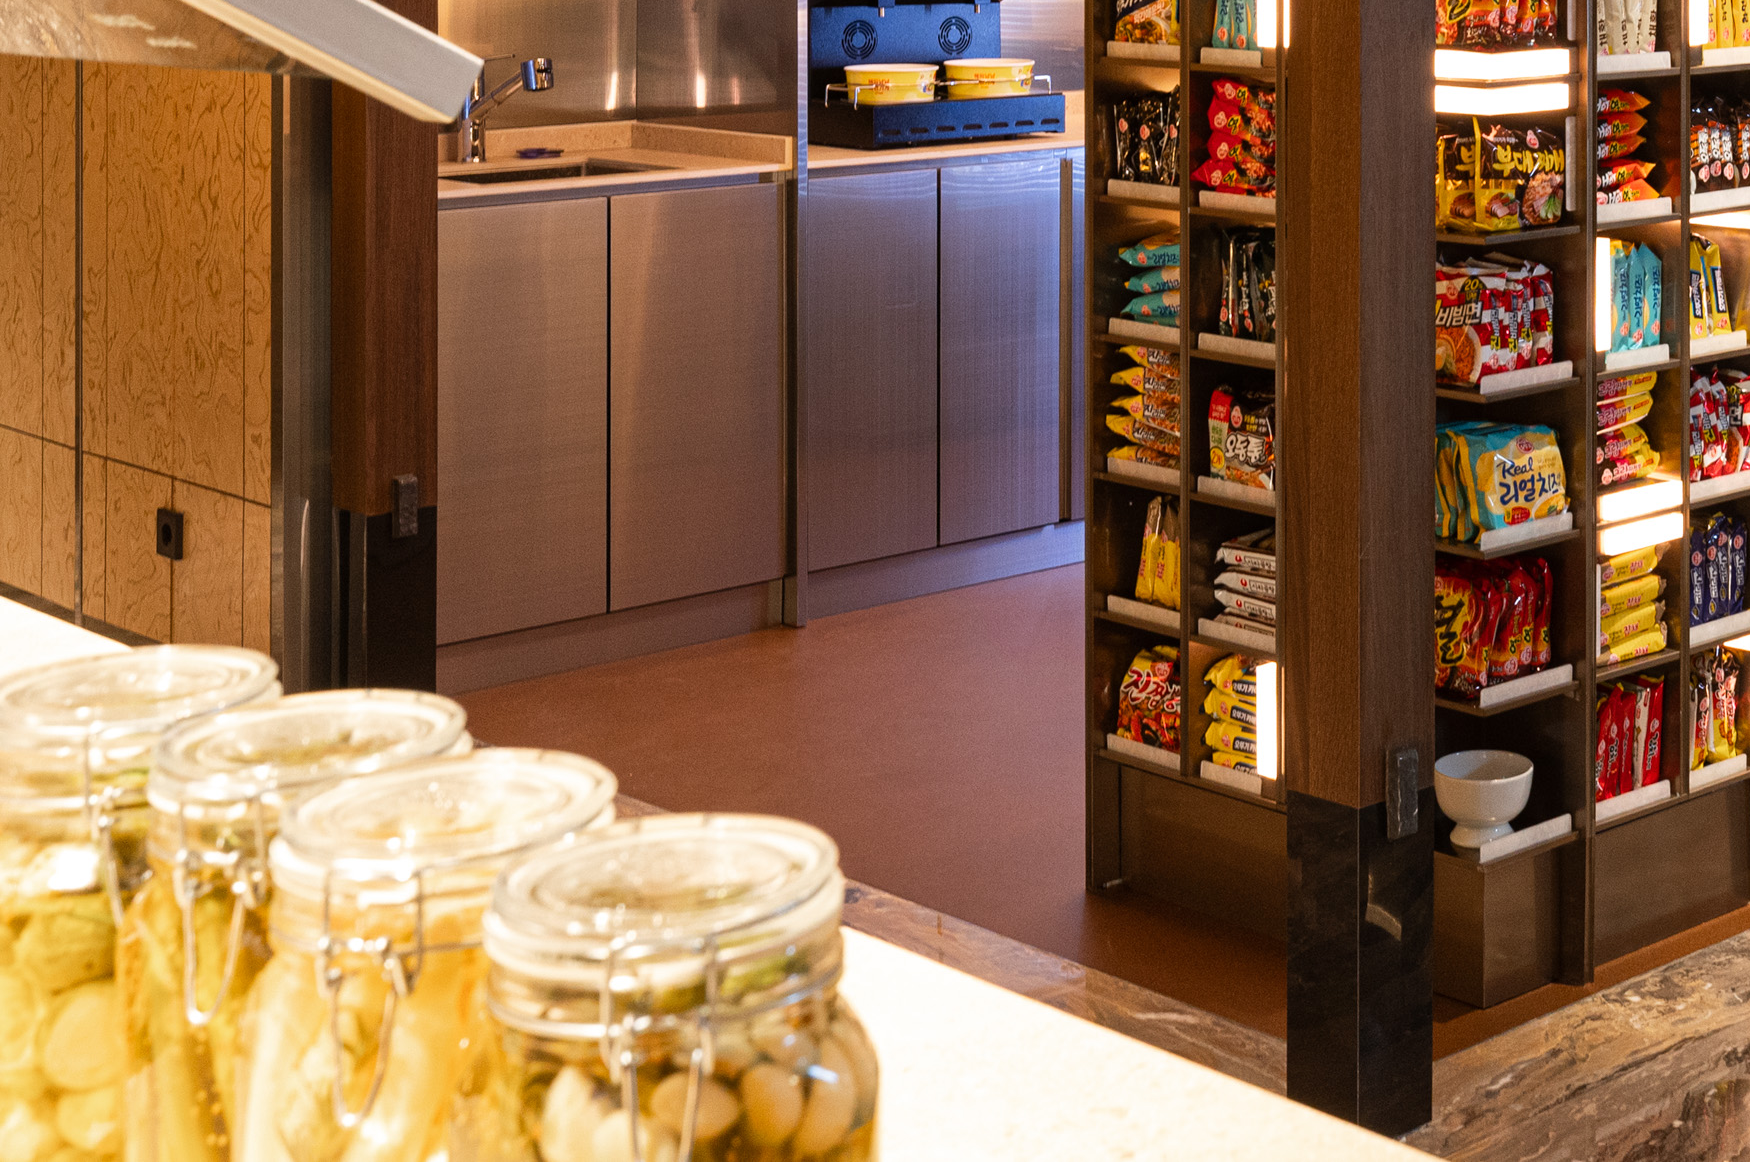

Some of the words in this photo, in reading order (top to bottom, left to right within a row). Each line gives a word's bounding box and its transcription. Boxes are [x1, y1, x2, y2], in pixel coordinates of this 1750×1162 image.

[1436, 299, 1483, 327] 비빔면
[1225, 432, 1265, 465] 오동통
[1496, 456, 1533, 479] Real
